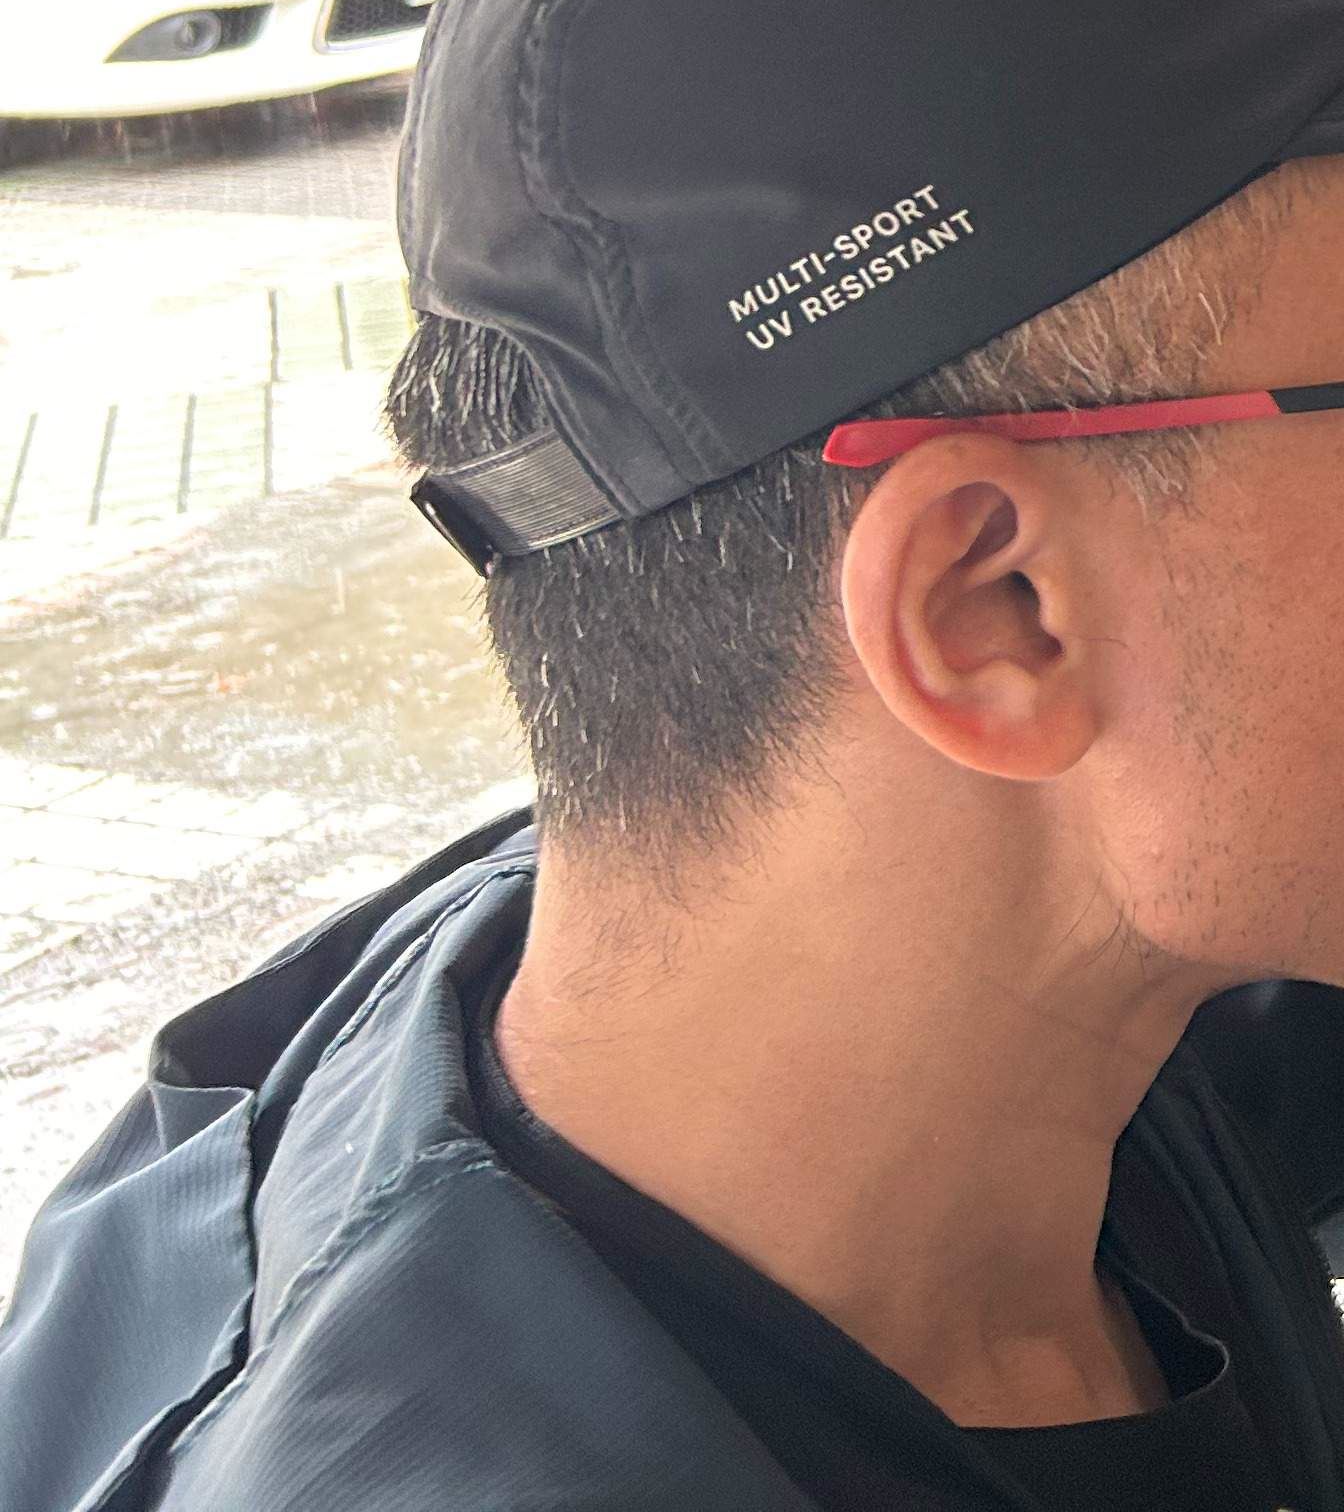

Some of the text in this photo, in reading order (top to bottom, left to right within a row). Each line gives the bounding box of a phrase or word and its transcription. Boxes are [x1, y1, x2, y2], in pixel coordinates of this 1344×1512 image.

[727, 184, 940, 322] MULTI-SPORT
[746, 209, 975, 351] UV RESISTANT
